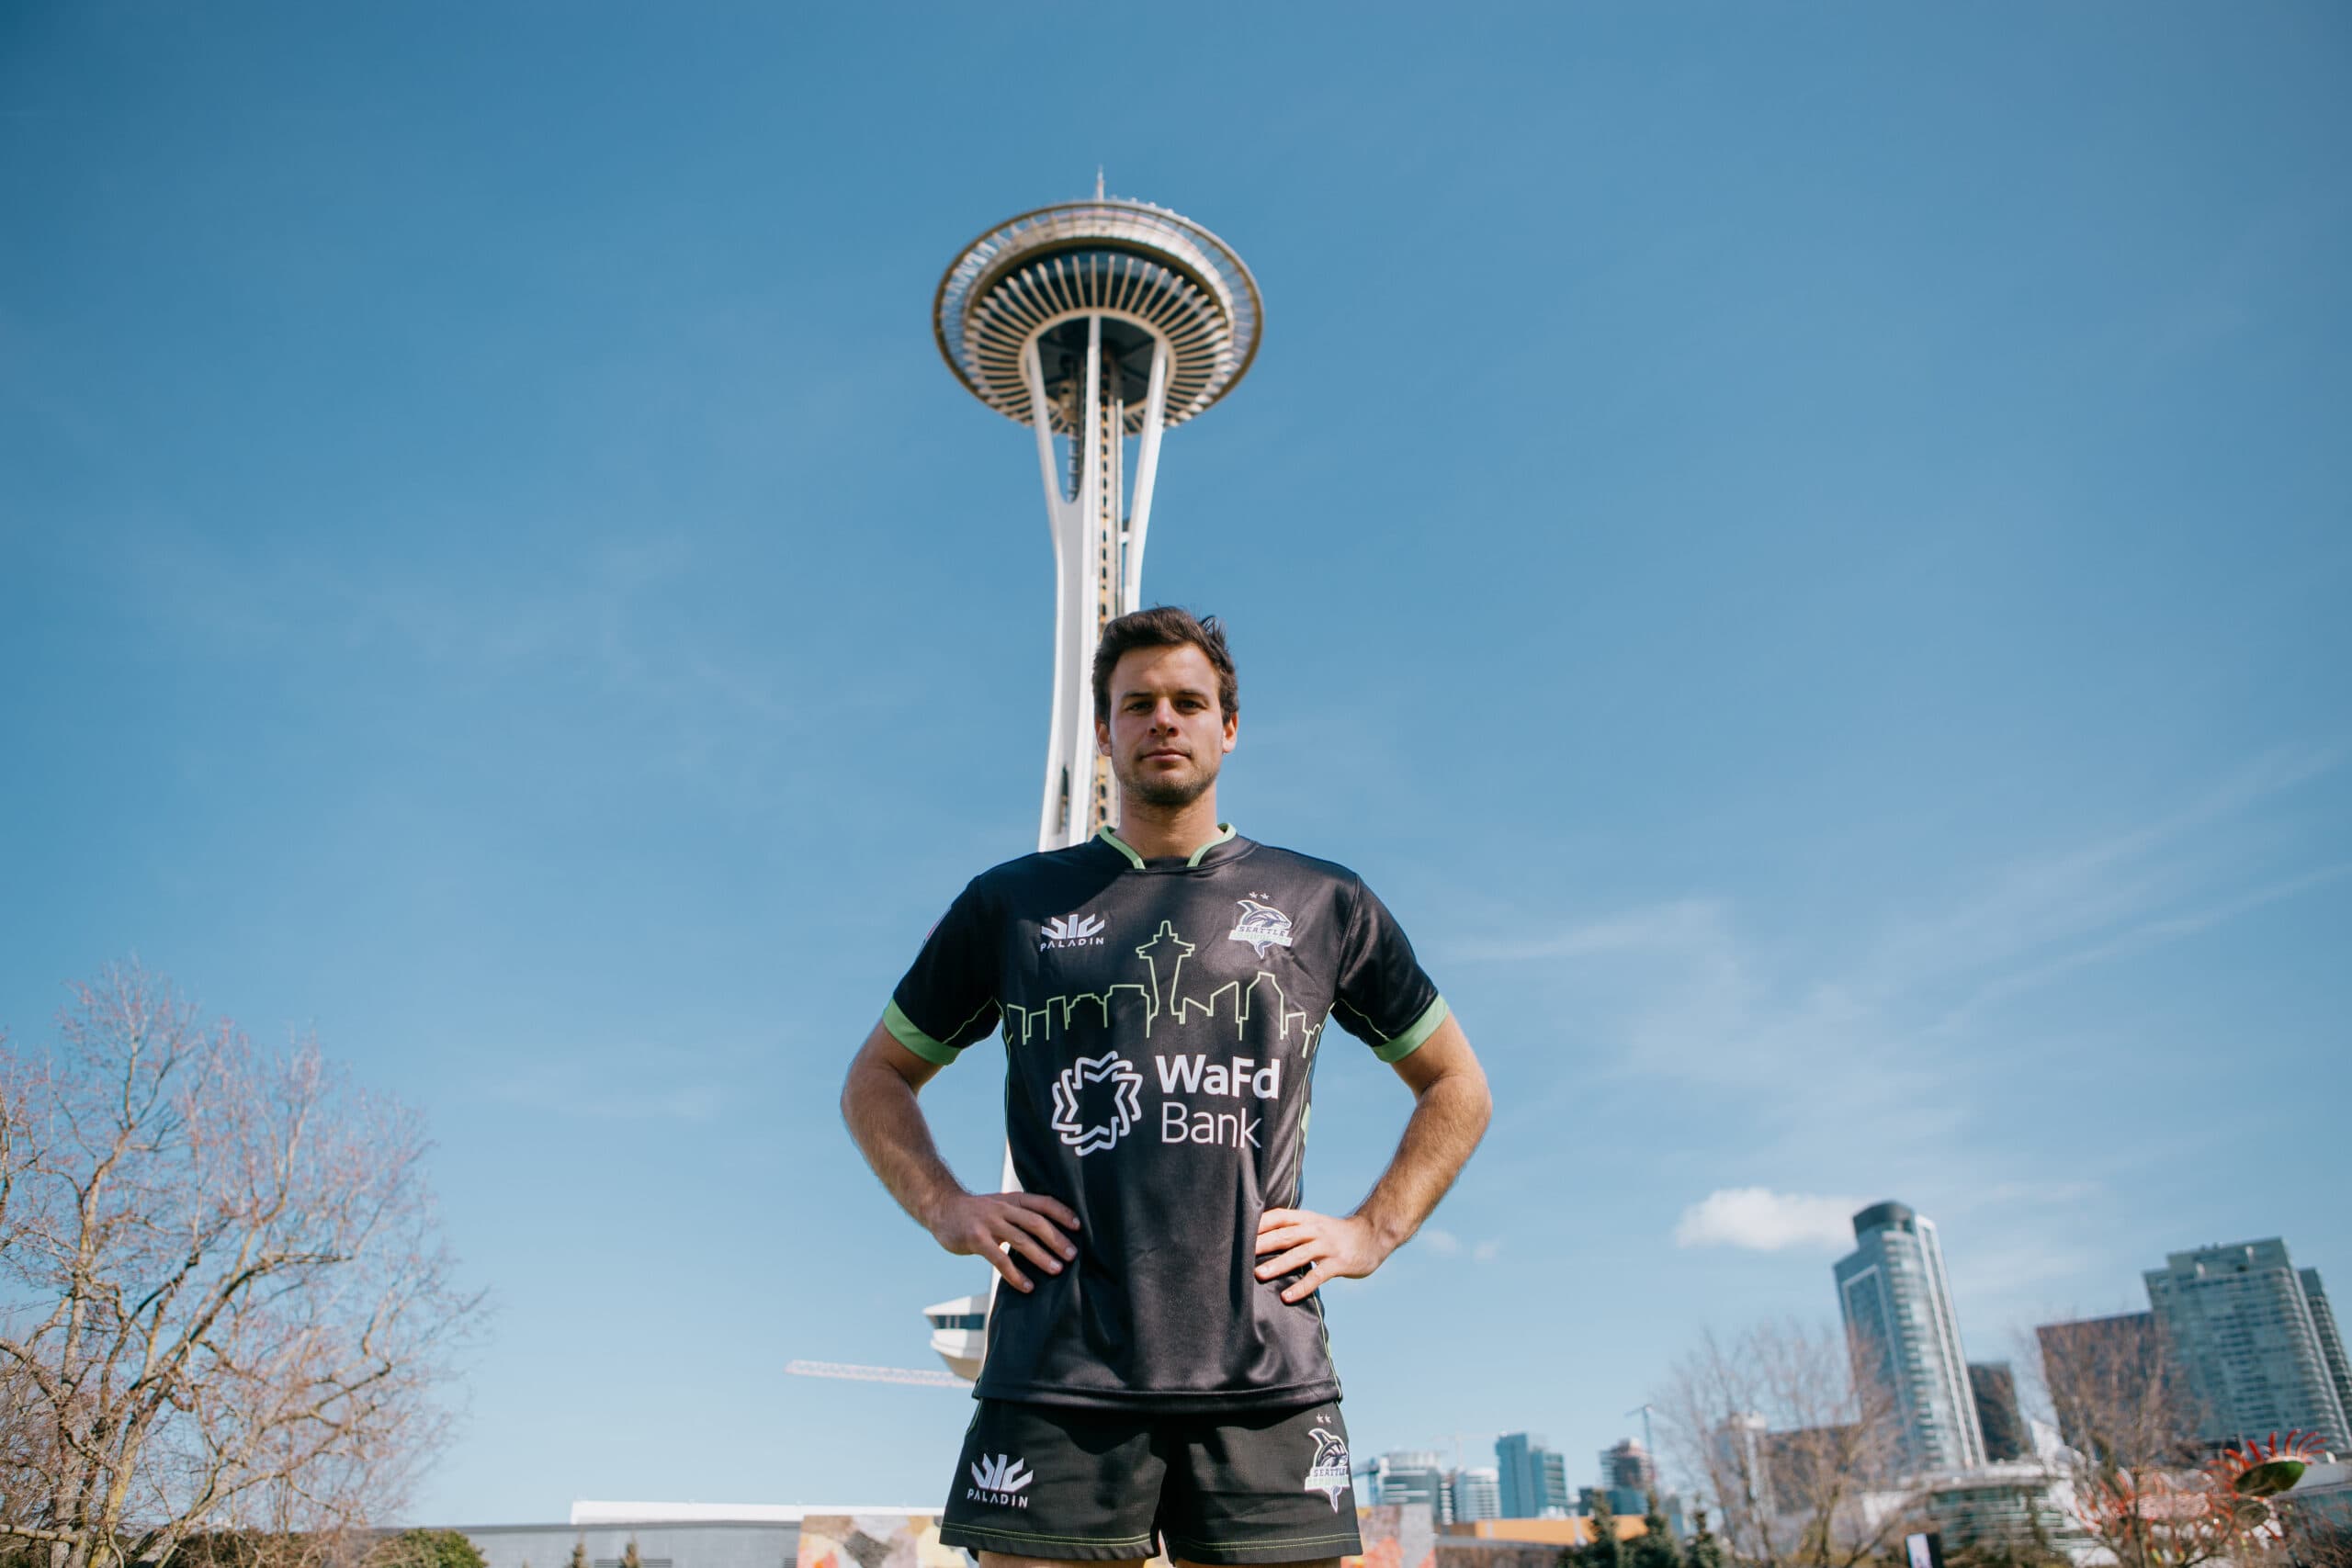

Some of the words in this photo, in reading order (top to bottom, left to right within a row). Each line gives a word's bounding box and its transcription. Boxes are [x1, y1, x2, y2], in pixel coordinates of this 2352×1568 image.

[1238, 925, 1286, 938] SEATTLE
[1040, 937, 1104, 952] PALADIN
[1155, 1054, 1281, 1100] WaFd
[1161, 1101, 1262, 1148] Bank
[967, 1488, 1028, 1508] PALADIN
